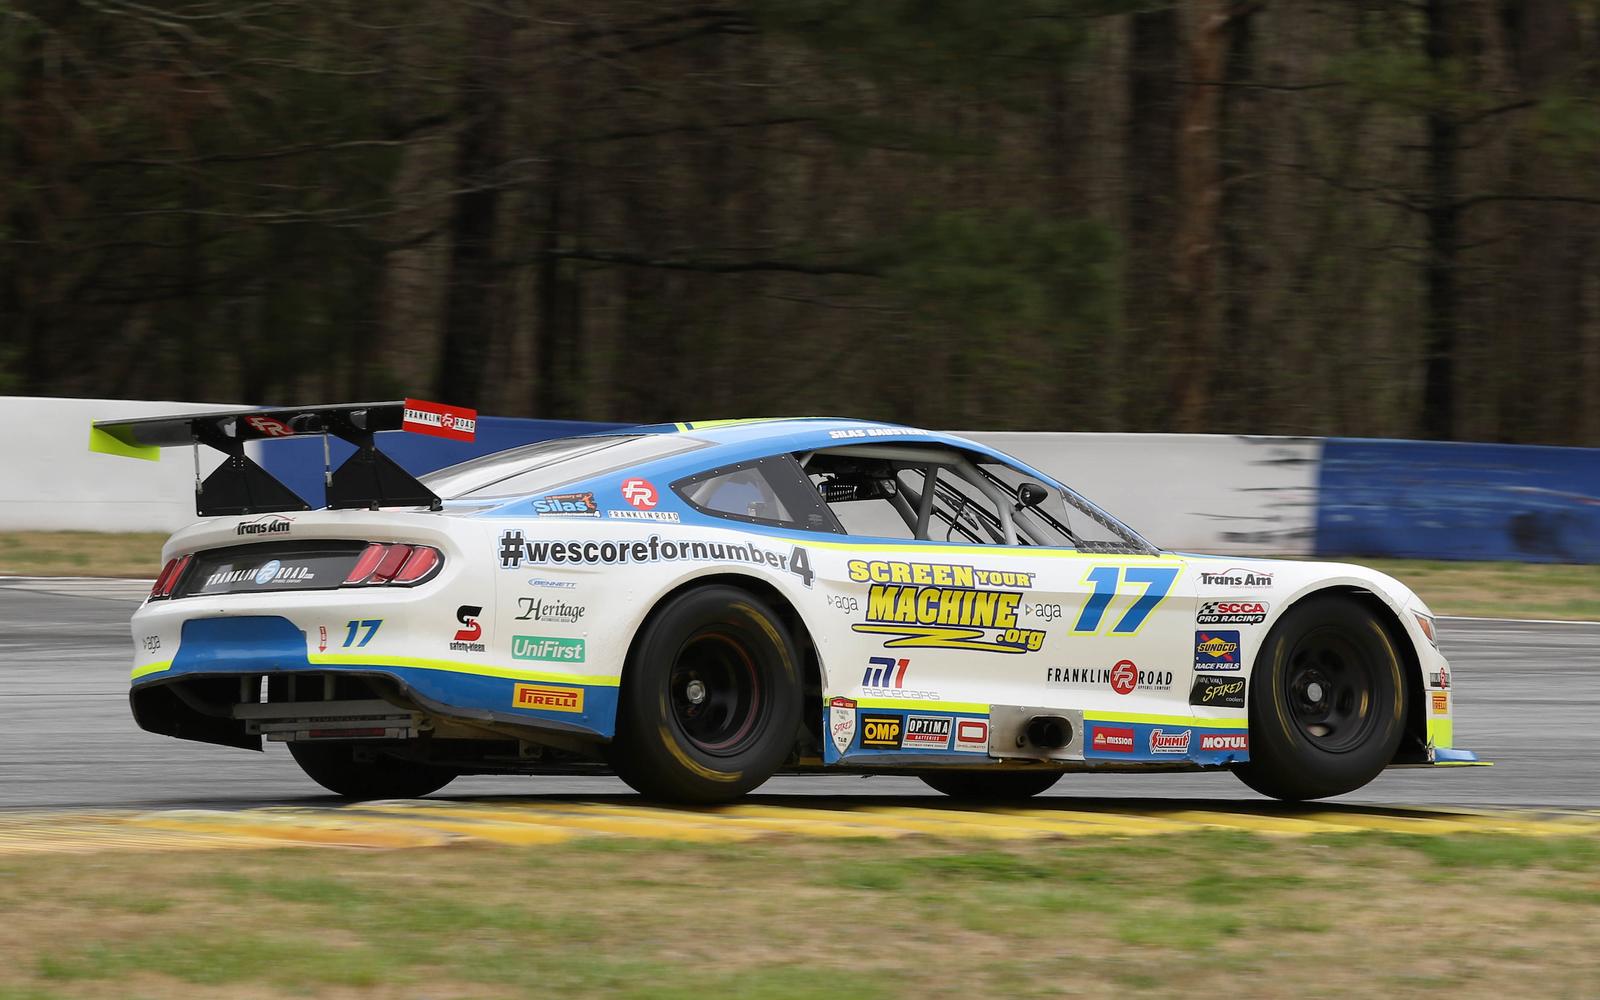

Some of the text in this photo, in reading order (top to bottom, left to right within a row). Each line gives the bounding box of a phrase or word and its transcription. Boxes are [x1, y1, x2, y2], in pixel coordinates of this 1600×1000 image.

[404, 409, 440, 423] FRANKLIN
[456, 417, 474, 429] ROAD
[829, 430, 866, 439] SILAS
[533, 498, 588, 513] Silas
[608, 510, 653, 519] FRANKLIN
[656, 512, 679, 521] ROAD
[237, 520, 290, 535] Trans Am
[500, 531, 815, 588] #wescorefornumber4
[205, 568, 259, 586] FRANKLIN
[848, 560, 1032, 588] SCREEN YOUR
[1201, 572, 1271, 586] Trans Am
[835, 596, 858, 613] aga
[866, 584, 1023, 629] MACHINE
[1070, 564, 1181, 634] 17
[1217, 603, 1265, 613] SCCA
[514, 597, 585, 623] Heritage
[1035, 602, 1062, 621] aga
[342, 620, 383, 647] 17
[996, 628, 1046, 651] .org
[513, 639, 582, 659] UniFirst
[1198, 643, 1235, 652] SUNOCO
[1047, 667, 1110, 683] FRANKLIN
[1138, 671, 1173, 685] ROAD
[520, 688, 577, 707] PIRELLI
[1202, 681, 1243, 702] SPIKED
[864, 723, 899, 740] OMP
[909, 719, 948, 733] OPTIMA
[1202, 736, 1246, 748] MOTUL
